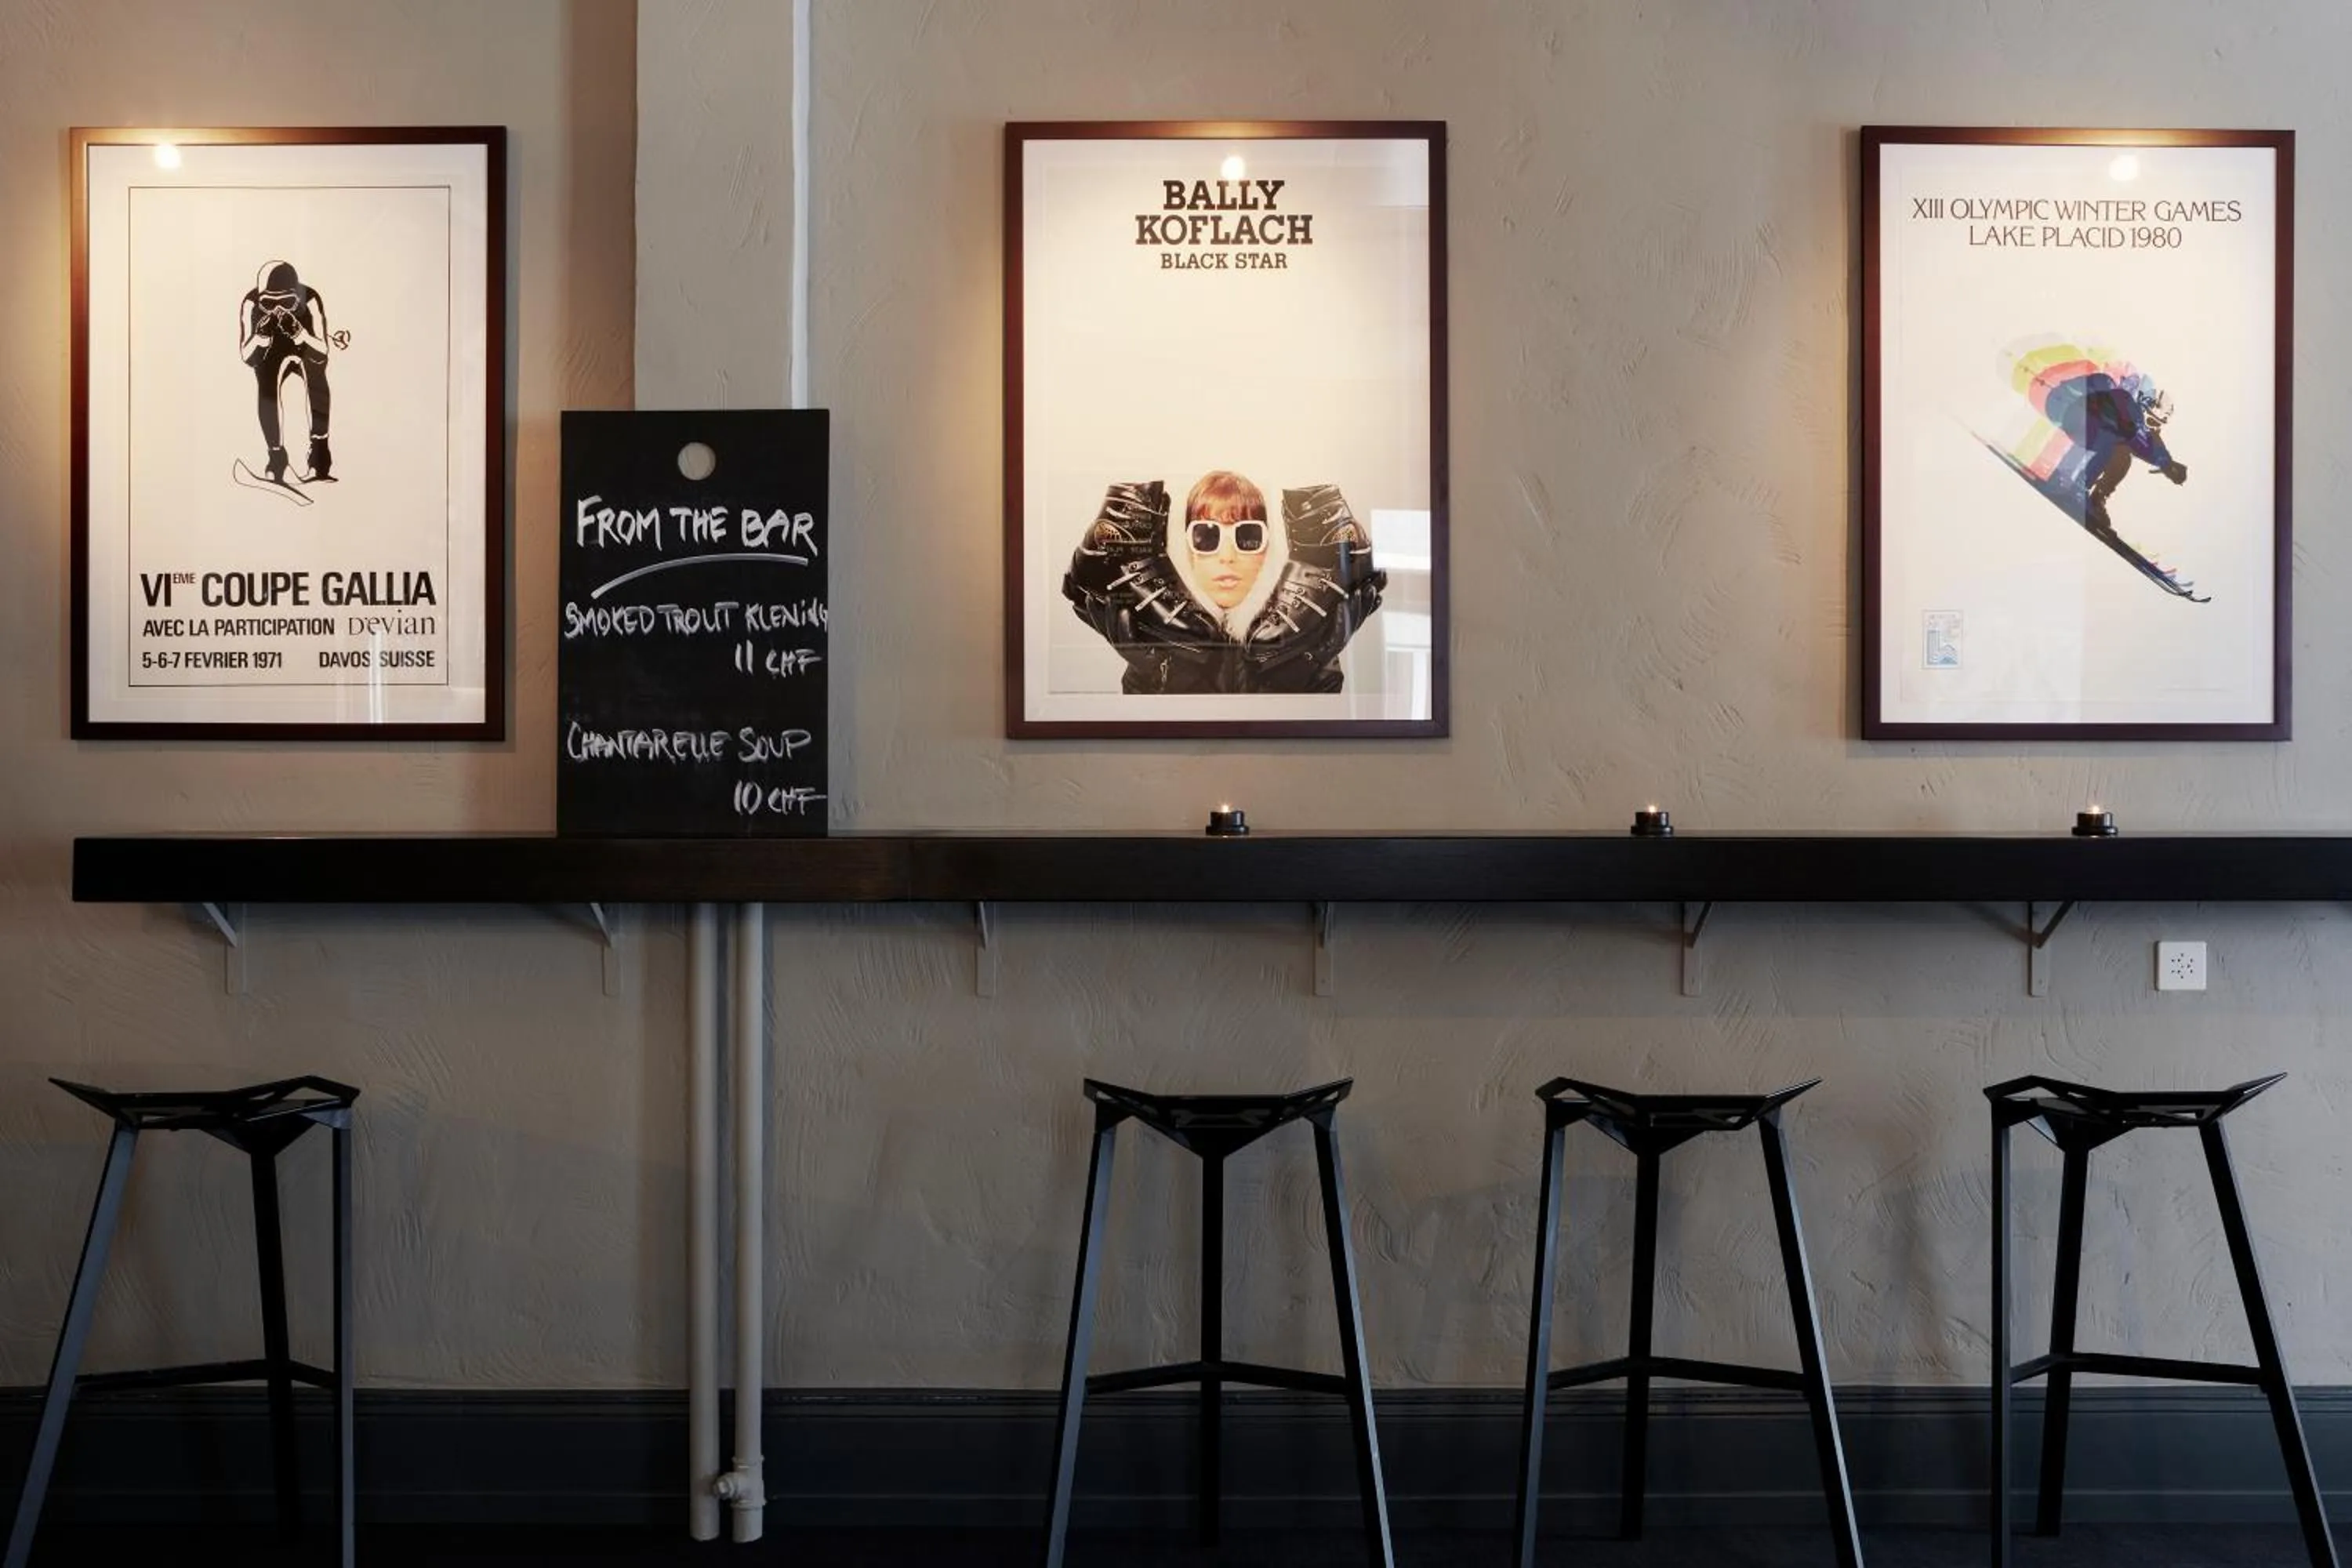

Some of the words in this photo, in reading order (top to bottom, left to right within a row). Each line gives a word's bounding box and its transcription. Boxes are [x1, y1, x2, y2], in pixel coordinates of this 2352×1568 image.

[1163, 180, 1284, 211] BALLY
[1912, 198, 1944, 219] XIII
[1950, 198, 2049, 220] OLYMPIC
[2053, 200, 2146, 222] WINTER
[2154, 200, 2241, 222] GAMES
[1134, 214, 1313, 245] KOFLACH
[1969, 225, 2035, 247] LAKE
[2042, 226, 2125, 249] PLACID
[2130, 227, 2182, 249] 1980
[1160, 252, 1229, 270] BLACK
[1235, 252, 1288, 269] STAR
[576, 495, 662, 551] FROM
[669, 506, 728, 543] THE
[740, 509, 818, 557] BAR
[201, 572, 310, 608] COUPE
[321, 571, 437, 606] GALLIA
[143, 619, 184, 637] AVEC
[189, 619, 209, 637] LA
[214, 618, 335, 637] PARTICIPATION
[564, 601, 655, 639] SMOKED
[656, 601, 739, 636] TROUT
[142, 652, 181, 669] 5-6-7
[184, 652, 249, 669] FEVRIER
[252, 652, 282, 669] 1971
[319, 651, 371, 668] DAVOS
[380, 650, 435, 668] SUISSE
[735, 639, 753, 673] 11
[765, 648, 821, 678] CHF
[738, 726, 811, 763] SOUP
[733, 780, 763, 815] 10
[768, 786, 827, 815] CHF
